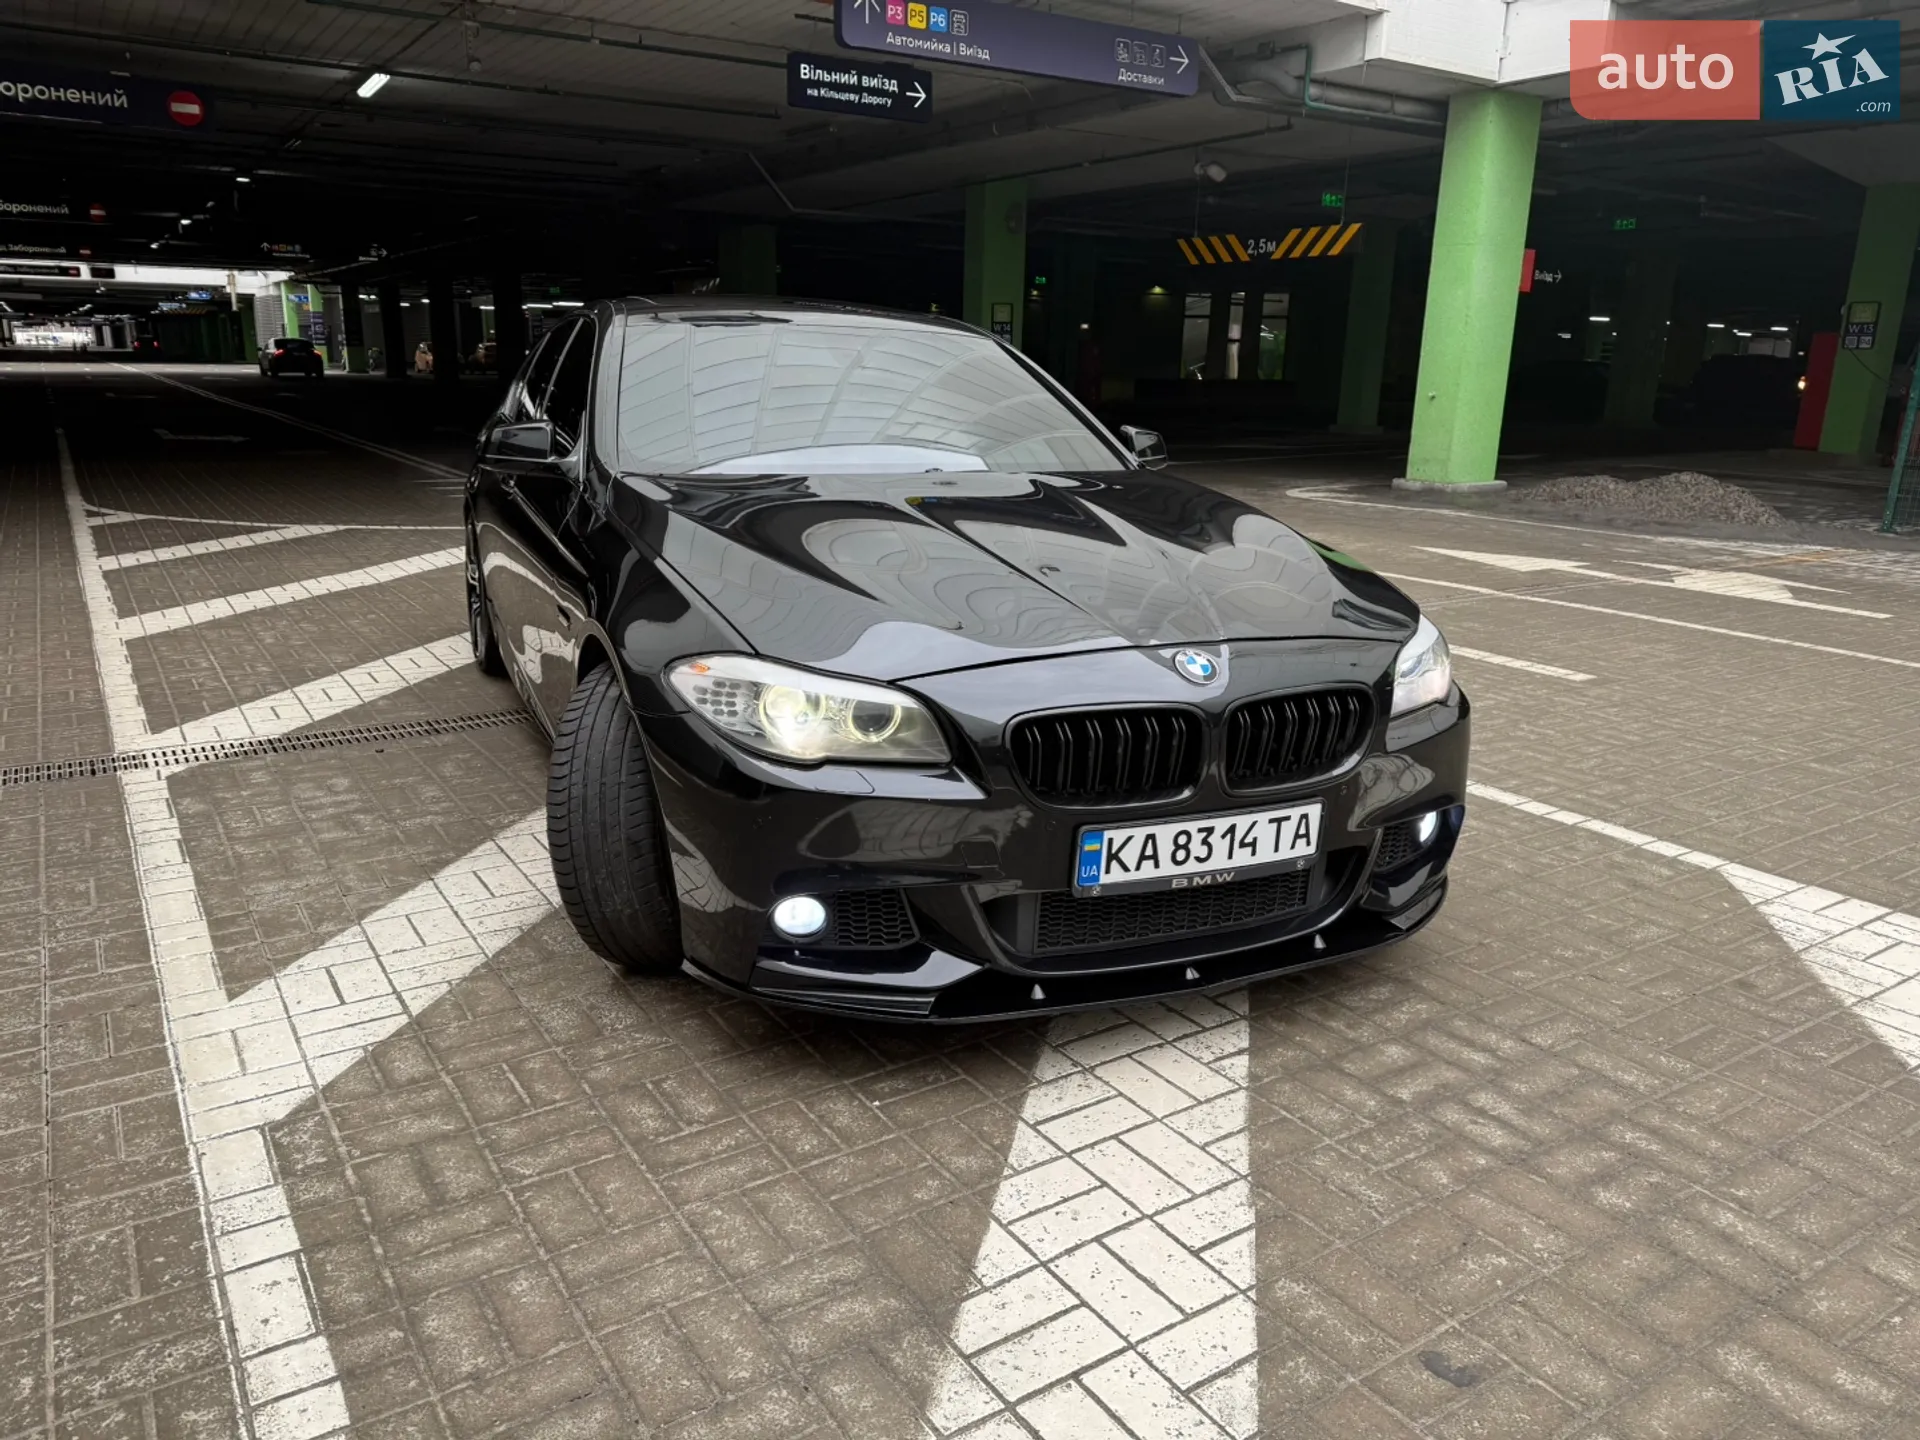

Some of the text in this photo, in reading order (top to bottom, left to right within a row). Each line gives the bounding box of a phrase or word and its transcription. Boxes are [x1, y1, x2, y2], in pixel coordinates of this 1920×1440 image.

[887, 5, 946, 27] P3 P5 P6
[886, 32, 951, 53] Автомийка
[959, 42, 991, 61] Виїзд
[800, 63, 899, 94] Вільний виїзд
[1118, 68, 1165, 86] Доставки
[0, 81, 128, 108] оронений
[806, 87, 893, 107] на Кільцеву Дорогу
[1081, 812, 1313, 878] UA KA 8314 TA
[1171, 872, 1235, 889] BMW
